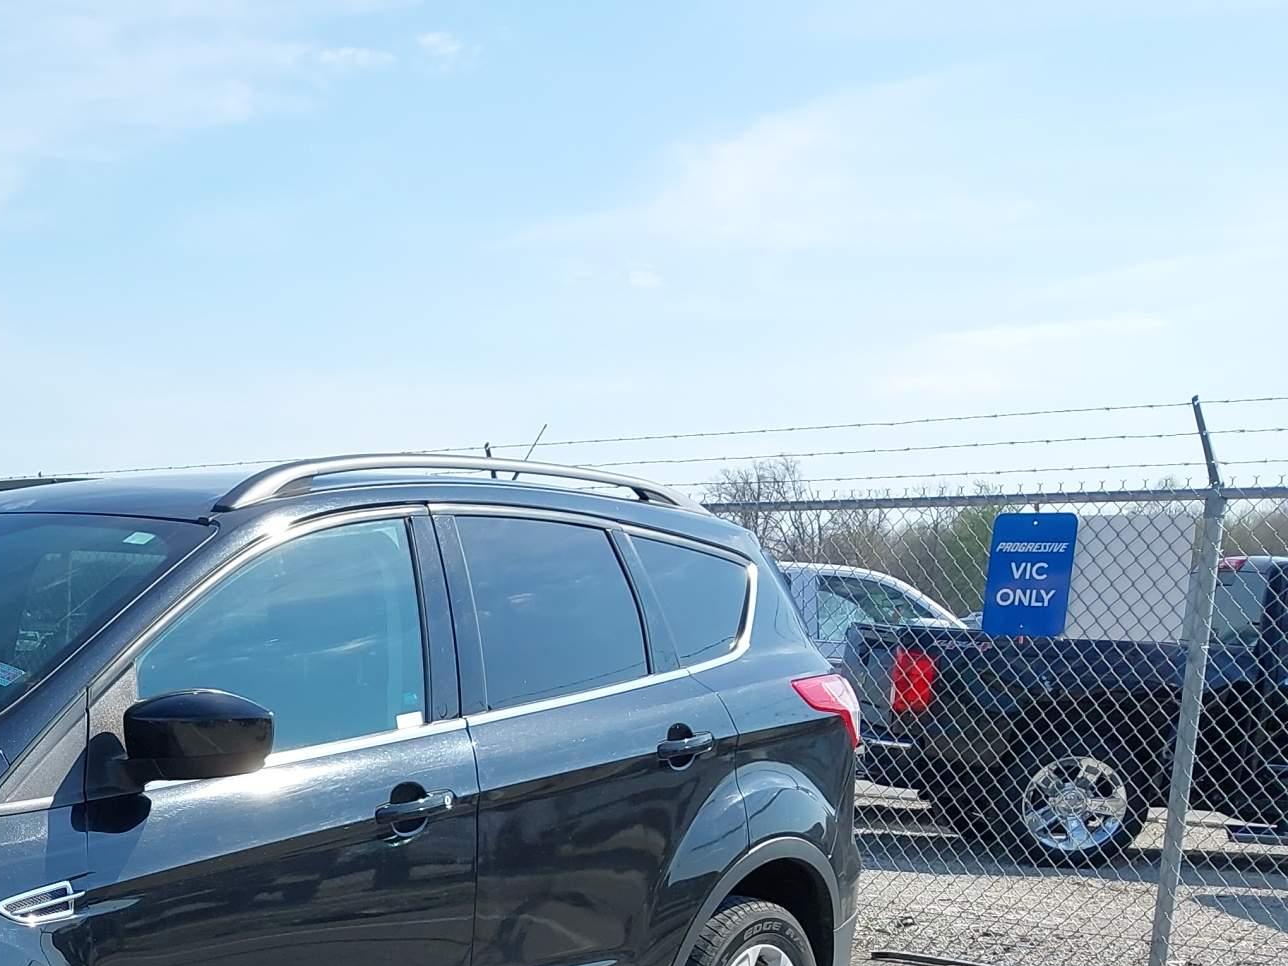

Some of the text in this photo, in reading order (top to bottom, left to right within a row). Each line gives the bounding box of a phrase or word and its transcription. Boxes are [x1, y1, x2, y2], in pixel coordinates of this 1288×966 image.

[996, 542, 1069, 553] PROGRESSIVE
[1011, 562, 1049, 580] VIC
[996, 588, 1056, 607] ONLY
[743, 921, 782, 941] EDGE
